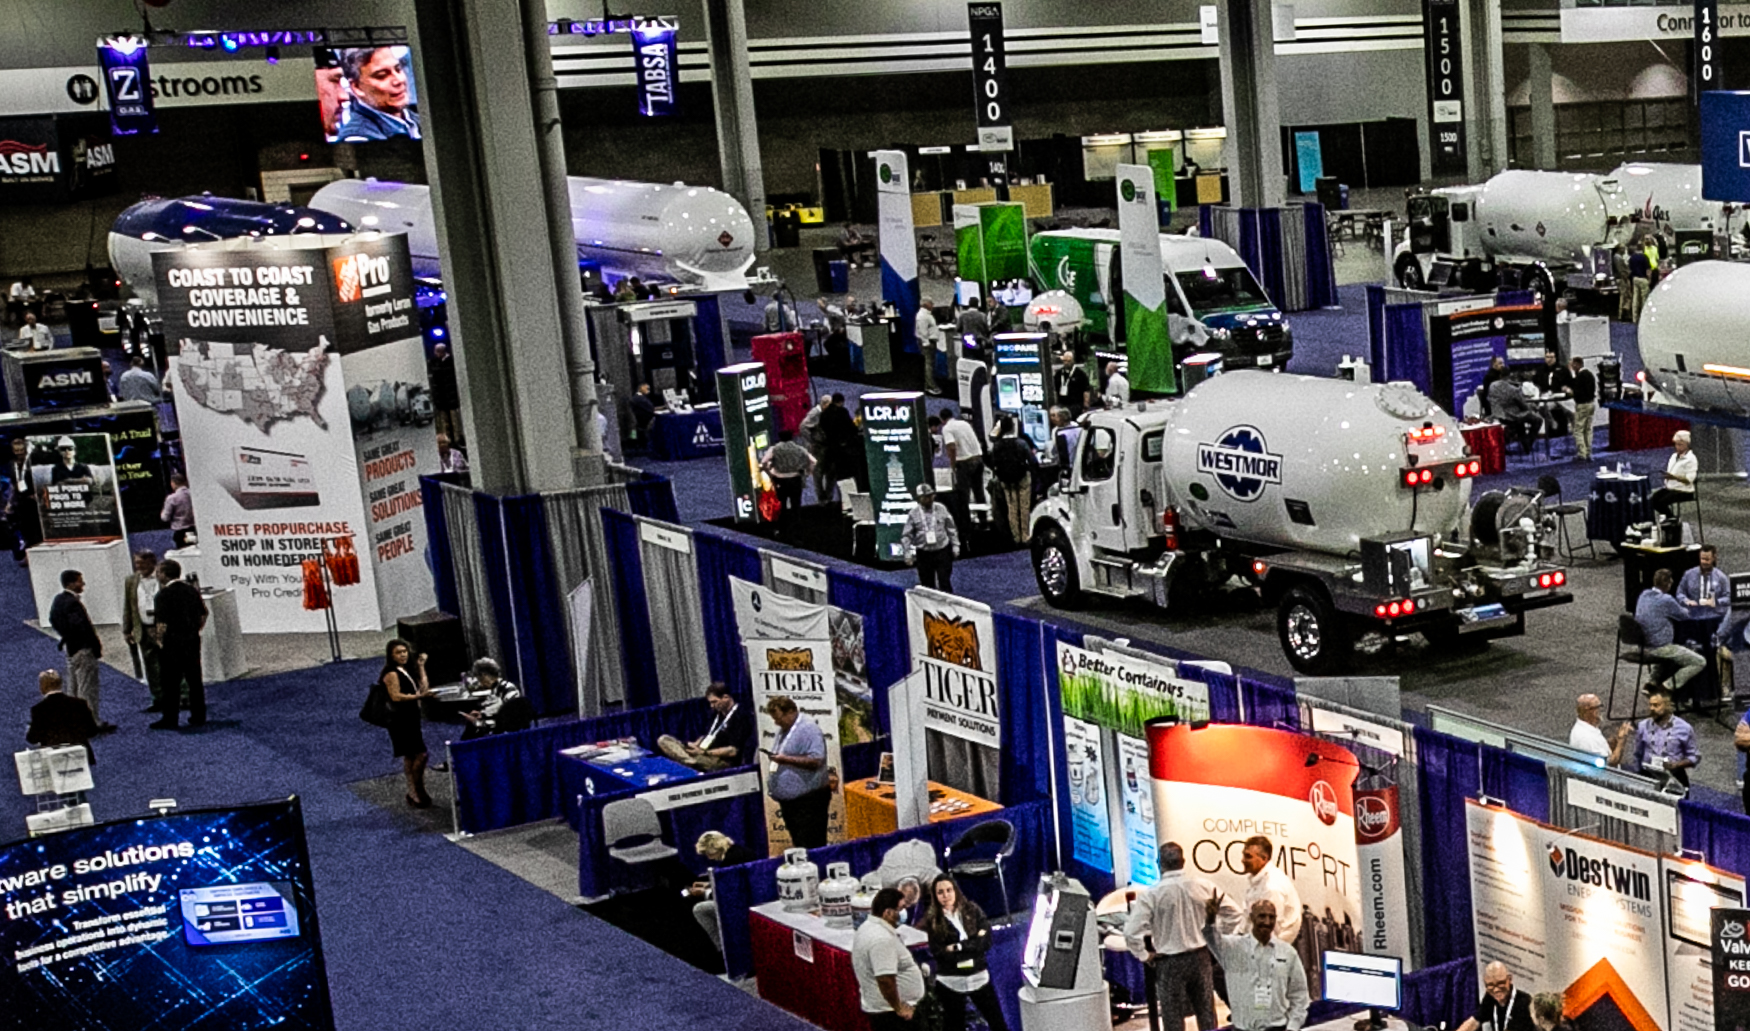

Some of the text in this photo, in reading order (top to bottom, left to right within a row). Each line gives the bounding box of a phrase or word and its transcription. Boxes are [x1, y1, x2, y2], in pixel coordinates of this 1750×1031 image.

[970, 7, 999, 17] NPGA
[1440, 17, 1453, 95] 1500
[1701, 8, 1713, 81] 1600
[112, 69, 140, 101] Z
[640, 43, 669, 116] TABSA
[981, 33, 1001, 121] 1400
[1440, 132, 1458, 143] 1500
[86, 143, 115, 170] ASM
[168, 267, 227, 288] COAST
[228, 267, 251, 286] TO
[256, 266, 314, 285] COAST
[357, 254, 390, 287] Pro
[189, 288, 300, 308] COVERAGE &
[188, 308, 309, 328] CONVENIENCE
[996, 343, 1039, 352] PROPANE
[38, 370, 93, 389] ASM
[364, 449, 416, 482] PRODUCTS
[1201, 449, 1279, 479] WESTMOR
[371, 488, 423, 523] SOLUTIONS
[214, 523, 249, 536] MEET
[221, 539, 275, 552] SHOP IN
[377, 534, 415, 563] PEOPLE
[221, 555, 240, 567] ON
[230, 574, 279, 587] Pay With
[251, 588, 271, 599] Pro
[1078, 653, 1115, 676] Better
[760, 671, 825, 692] TIGER
[919, 658, 1000, 719] TIGER
[926, 707, 996, 737] PAYMENT SOLUTIONS
[1203, 817, 1289, 839] COMPLETE
[1356, 799, 1388, 830] Rheem
[74, 841, 195, 875] solutions
[1565, 847, 1651, 902] Destwin
[5, 871, 162, 920] that simplify
[1373, 858, 1387, 951] Rheem.com
[72, 904, 167, 931] Transform essential
[15, 918, 168, 960] business operations into dynamic
[17, 930, 169, 973] tools for a competitive advantage
[1727, 975, 1750, 989] GO
